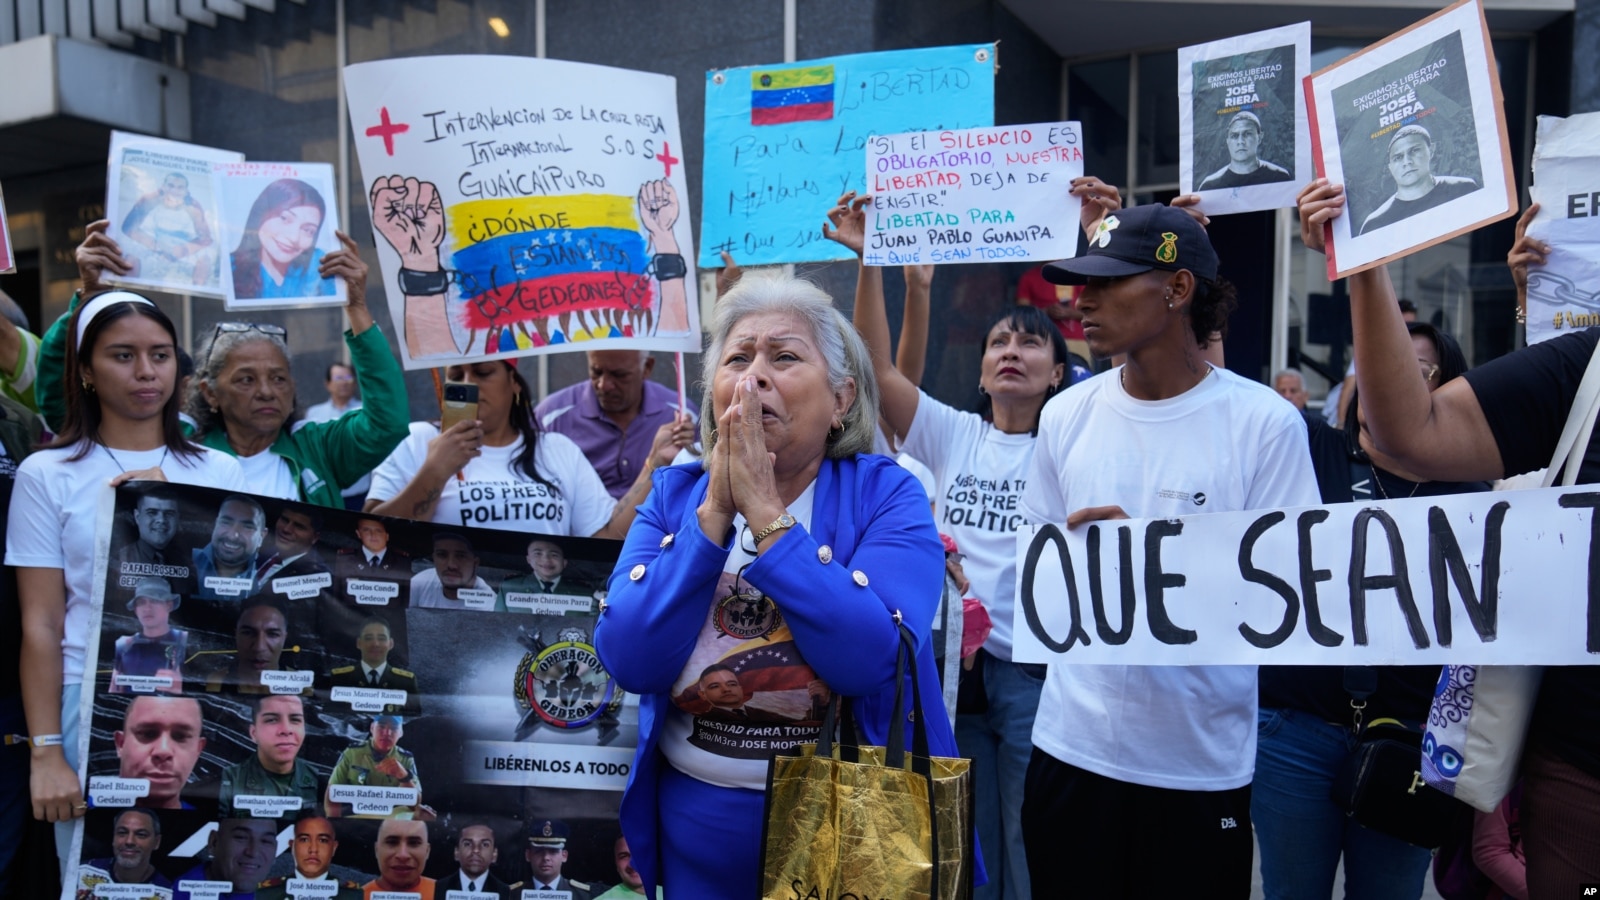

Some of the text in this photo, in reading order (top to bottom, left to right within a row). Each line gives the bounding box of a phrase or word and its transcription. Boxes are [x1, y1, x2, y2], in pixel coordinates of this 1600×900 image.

[1208, 64, 1282, 84] EXIGIMOS LIBERTAD
[1212, 72, 1276, 88] INMEDIATA PARA
[1226, 82, 1256, 97] JOSÉ
[1353, 58, 1447, 106] EXIGIMOS LIBERTAD
[1359, 70, 1440, 112] INMEDIATA PARA
[1225, 94, 1260, 107] RIERA
[1379, 88, 1416, 116] JOSÉ
[1380, 101, 1424, 128] RIERA
[940, 129, 1033, 149] SILENCIO
[1048, 126, 1077, 145] ES
[1006, 146, 1084, 166] NUESTRA
[971, 171, 1017, 190] DEJA
[1027, 172, 1050, 184] DE
[876, 208, 1015, 231] LIBERTAD PARA
[872, 231, 917, 250] JUAN
[927, 229, 972, 246] PABLO
[930, 247, 972, 262] SEAN
[1000, 480, 1010, 492] A
[460, 486, 496, 504] LOS
[946, 485, 1022, 511] LOS PRE
[460, 499, 564, 526] POLÍTICOS
[122, 562, 190, 578] RAFAEL ROSENDO
[1021, 520, 1197, 653] QUE
[1238, 501, 1510, 649] SEAN
[290, 588, 318, 597] Gedeon
[350, 583, 396, 592] Carlos Conde
[360, 594, 386, 602] Gedeon
[510, 594, 590, 606] Leandro Chirinos Parra
[536, 608, 562, 616] Gedeon
[728, 624, 764, 635] GEDEON
[540, 649, 604, 675] OPERACION
[264, 673, 288, 681] Cosme
[334, 688, 404, 700] Jesus Manuel Ramos
[354, 702, 380, 710] Gedeon
[541, 699, 596, 720] GEDEON
[698, 718, 745, 734] LIBERTAD
[746, 726, 782, 737] PARA
[740, 740, 768, 749] JOSE
[484, 755, 632, 776] LIBÉRENLOS A TODO
[114, 782, 146, 791] Blanco
[332, 788, 414, 800] Jesus Rafael Ramos
[96, 796, 132, 804] Gedeon
[236, 798, 266, 806] Jonathan
[357, 802, 389, 812] Gedeon
[254, 808, 279, 816] Gedeon
[98, 886, 152, 894] Alejandro Torres
[289, 882, 335, 891] José Moreno
